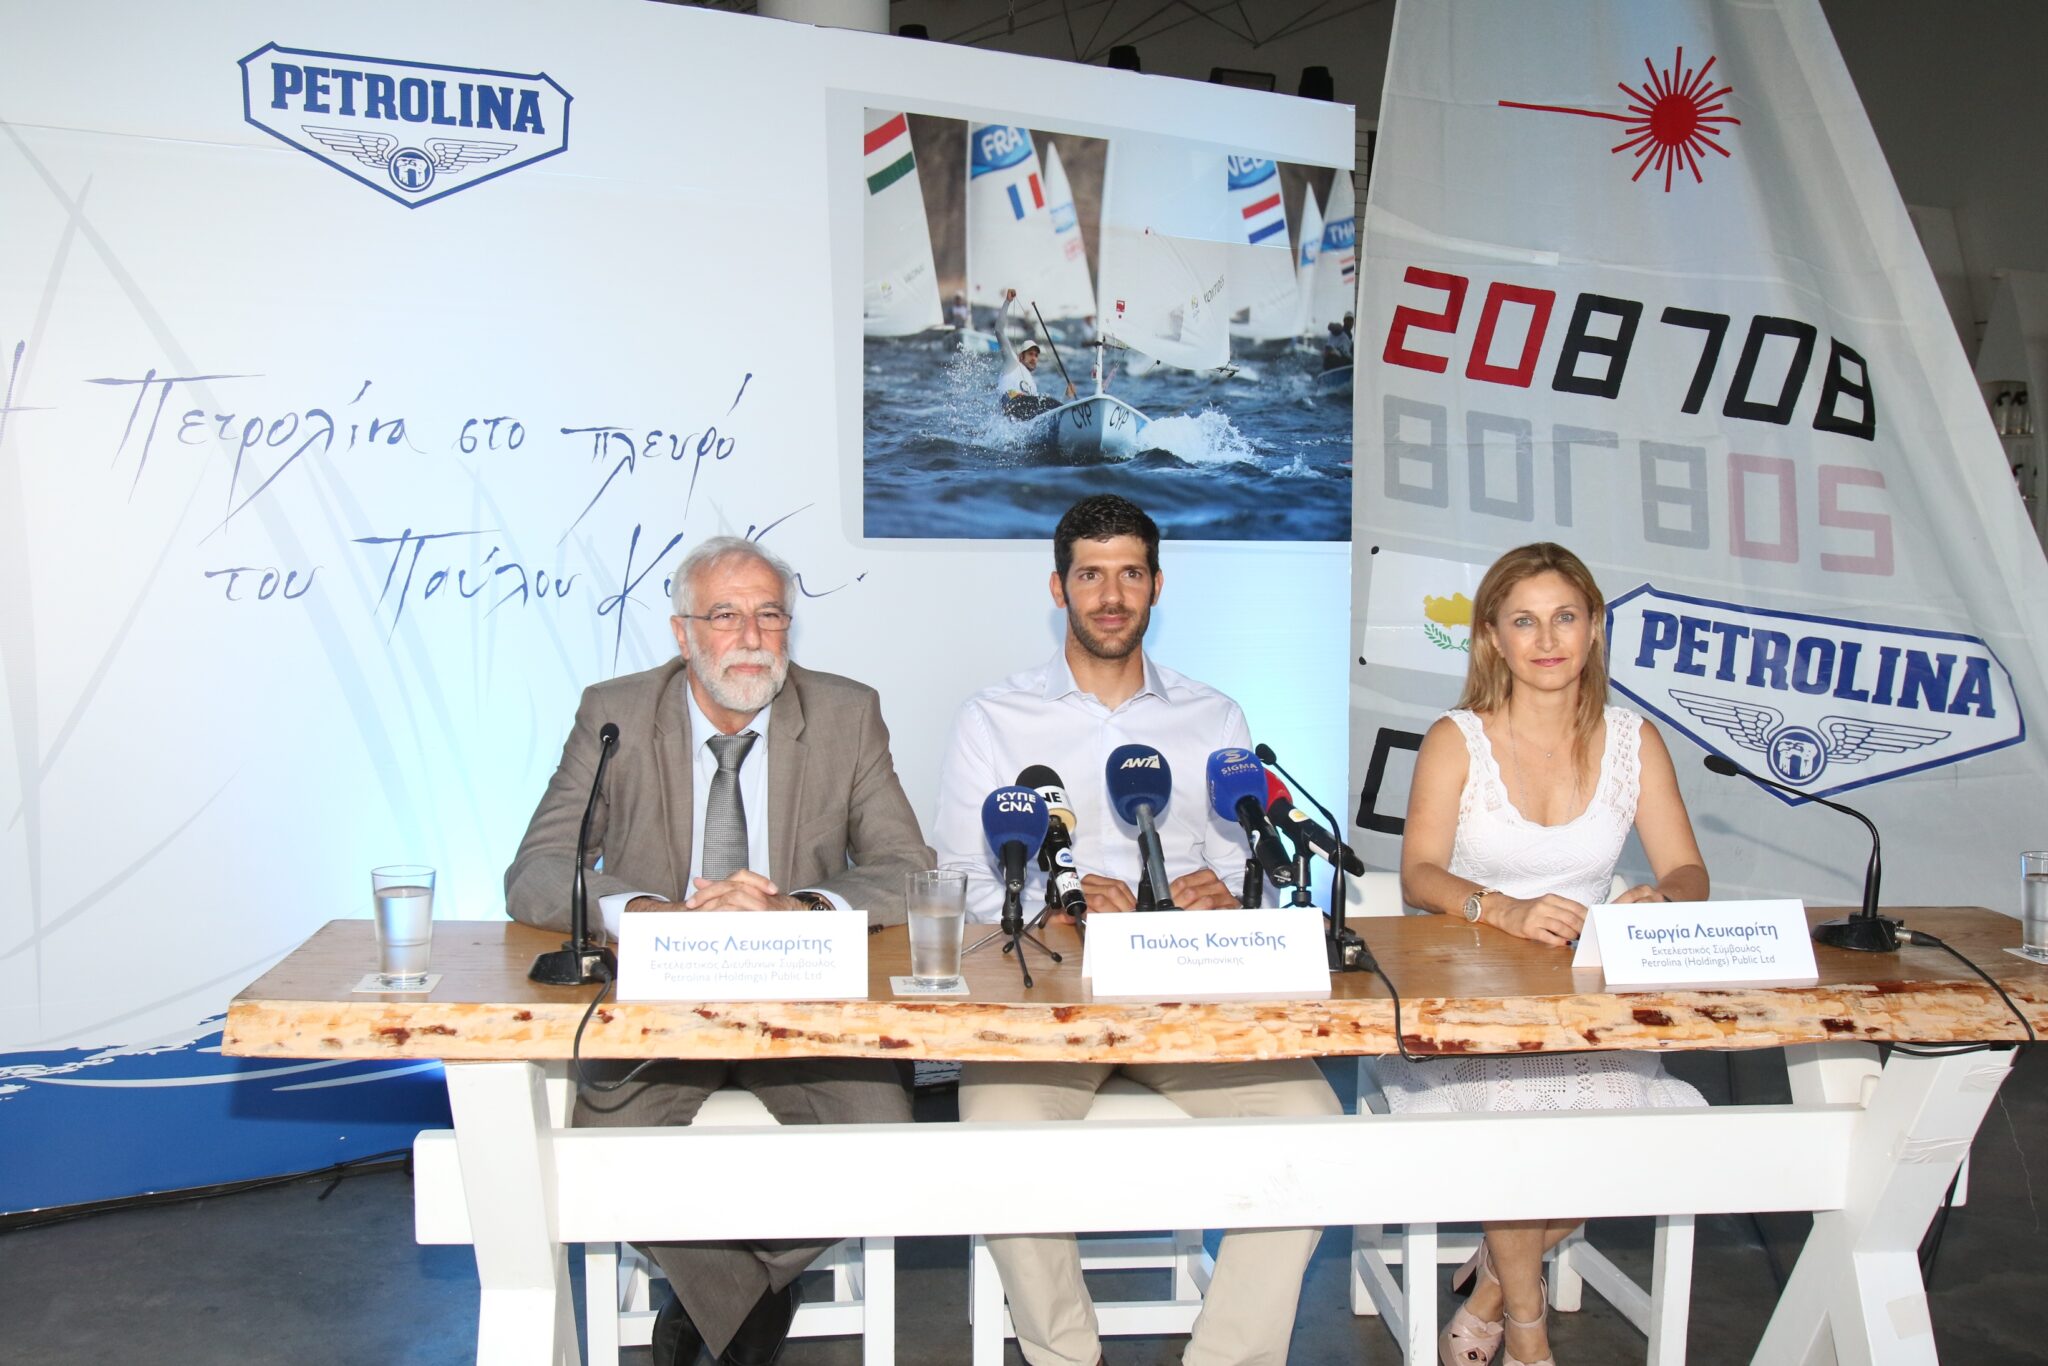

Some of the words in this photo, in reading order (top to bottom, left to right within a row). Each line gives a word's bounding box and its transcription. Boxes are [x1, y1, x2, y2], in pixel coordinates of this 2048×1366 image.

[271, 62, 546, 135] PETROLINA
[981, 126, 1024, 162] FRA
[1383, 266, 1877, 442] 208708
[1071, 403, 1092, 429] CYP
[1109, 405, 1129, 431] CYP
[82, 368, 428, 547] Πετρολίνα
[452, 416, 526, 454] στο
[556, 373, 752, 547] πλευρό
[204, 566, 325, 601] του
[351, 528, 582, 646] Παύλου
[1635, 609, 1997, 719] PETROLINA
[1221, 763, 1258, 775] SIGMA
[998, 801, 1034, 814] CNA
[1043, 791, 1063, 803] NE
[654, 936, 719, 955] Ντίνος
[724, 934, 833, 955] Λευκαρίτης
[1130, 934, 1199, 951] Παύλος
[1205, 931, 1287, 951] Κοντίδης
[1627, 924, 1690, 943] Γεωργία
[1694, 921, 1779, 941] Λευκαρίτη
[1641, 957, 1682, 968] Petrolina
[1684, 956, 1730, 968] (Holdings)
[1731, 955, 1758, 965] Public
[1760, 954, 1776, 964] Ltd
